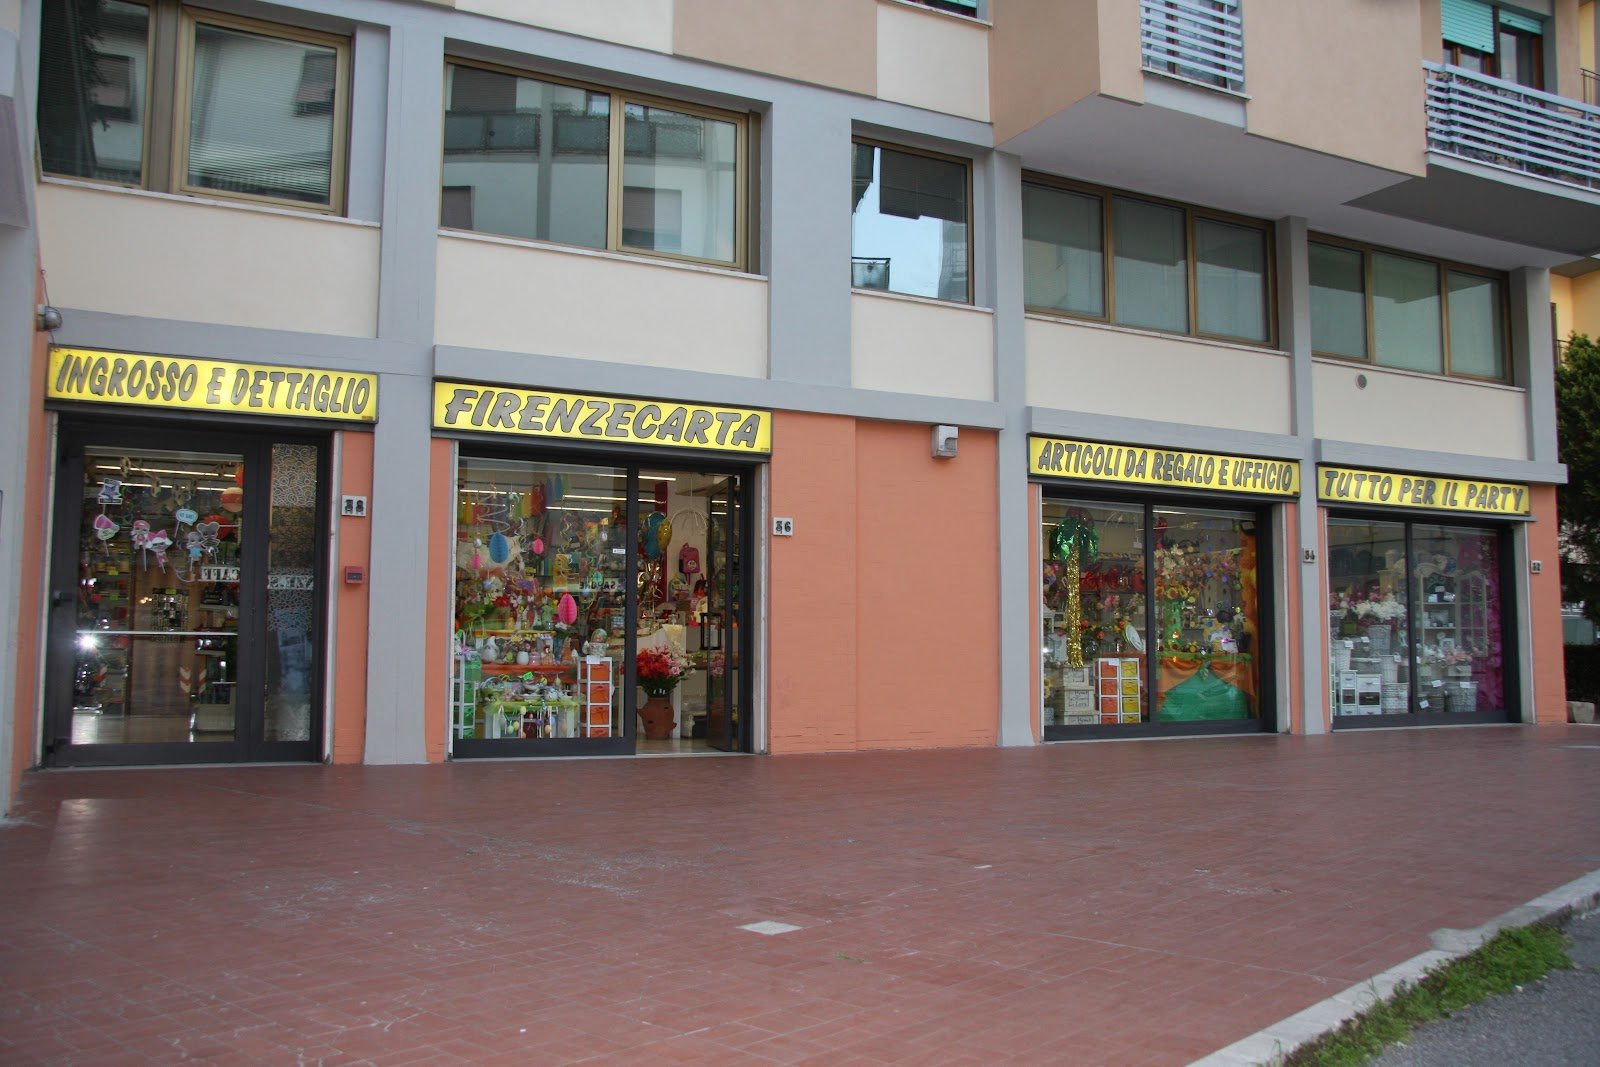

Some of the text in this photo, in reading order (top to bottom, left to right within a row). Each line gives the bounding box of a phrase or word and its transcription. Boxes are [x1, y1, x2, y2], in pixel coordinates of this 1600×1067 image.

[56, 354, 370, 415] INGROSSO E DETTAGLIO
[444, 388, 761, 449] FIRENZECARTA
[1038, 440, 1293, 492] ARTICOLI DA REGALO E UFFICIO
[1324, 470, 1524, 512] TUTTO PER IL PARTY
[776, 520, 792, 533] 36
